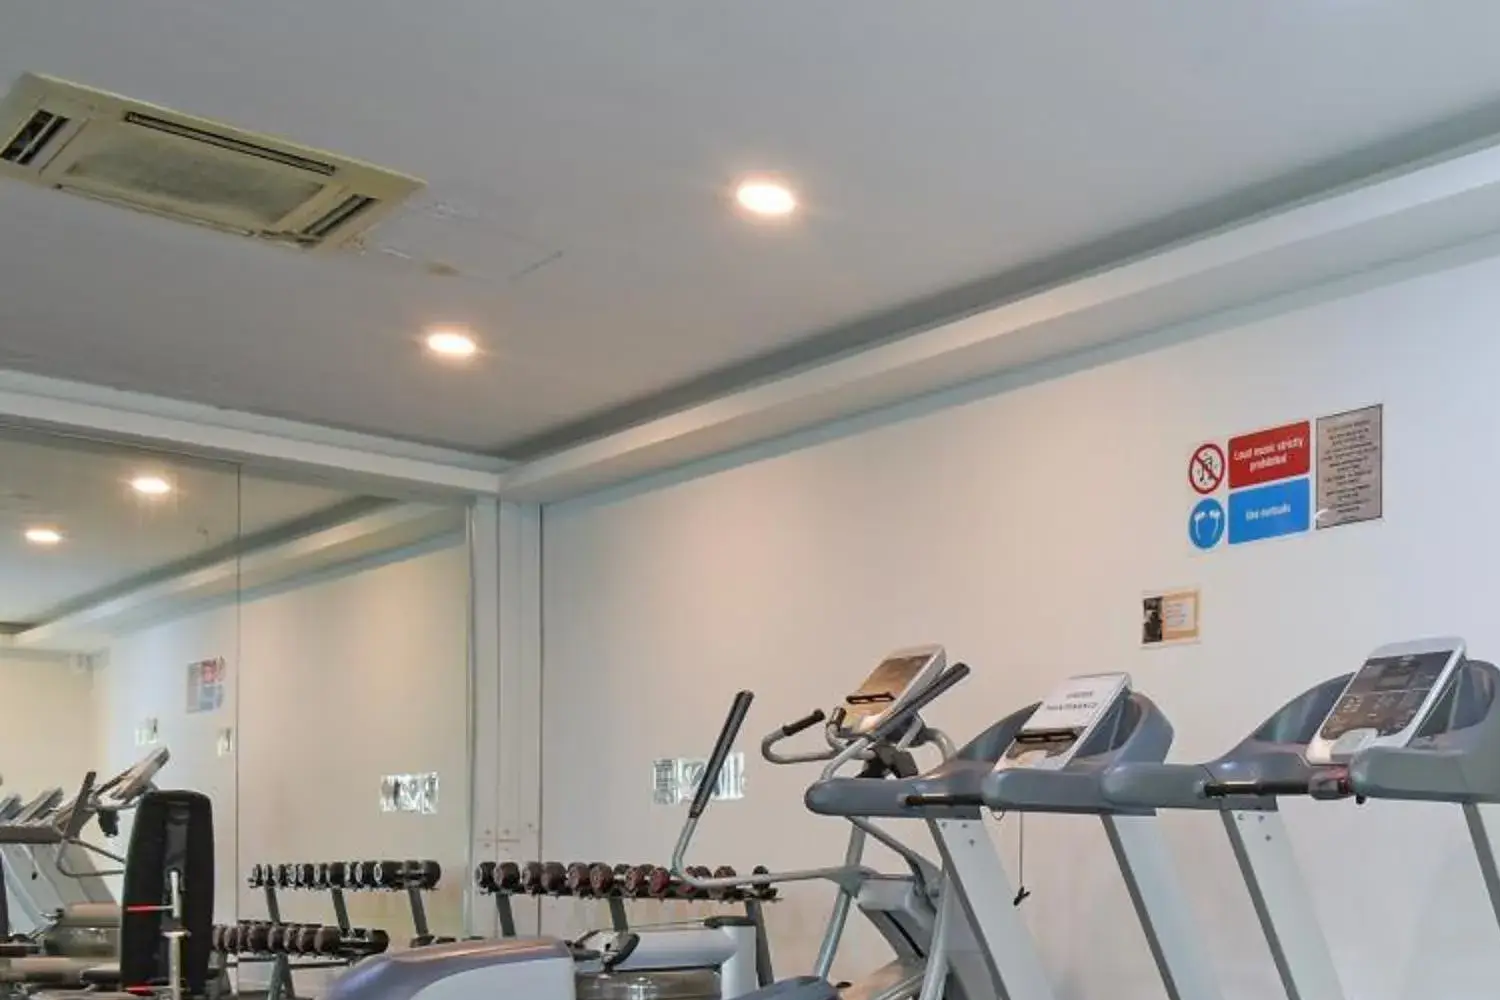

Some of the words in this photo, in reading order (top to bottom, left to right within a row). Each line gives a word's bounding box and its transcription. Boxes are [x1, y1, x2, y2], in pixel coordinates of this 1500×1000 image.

[1254, 443, 1275, 456] music
[1277, 436, 1304, 450] strictly
[1249, 452, 1287, 473] prohibited
